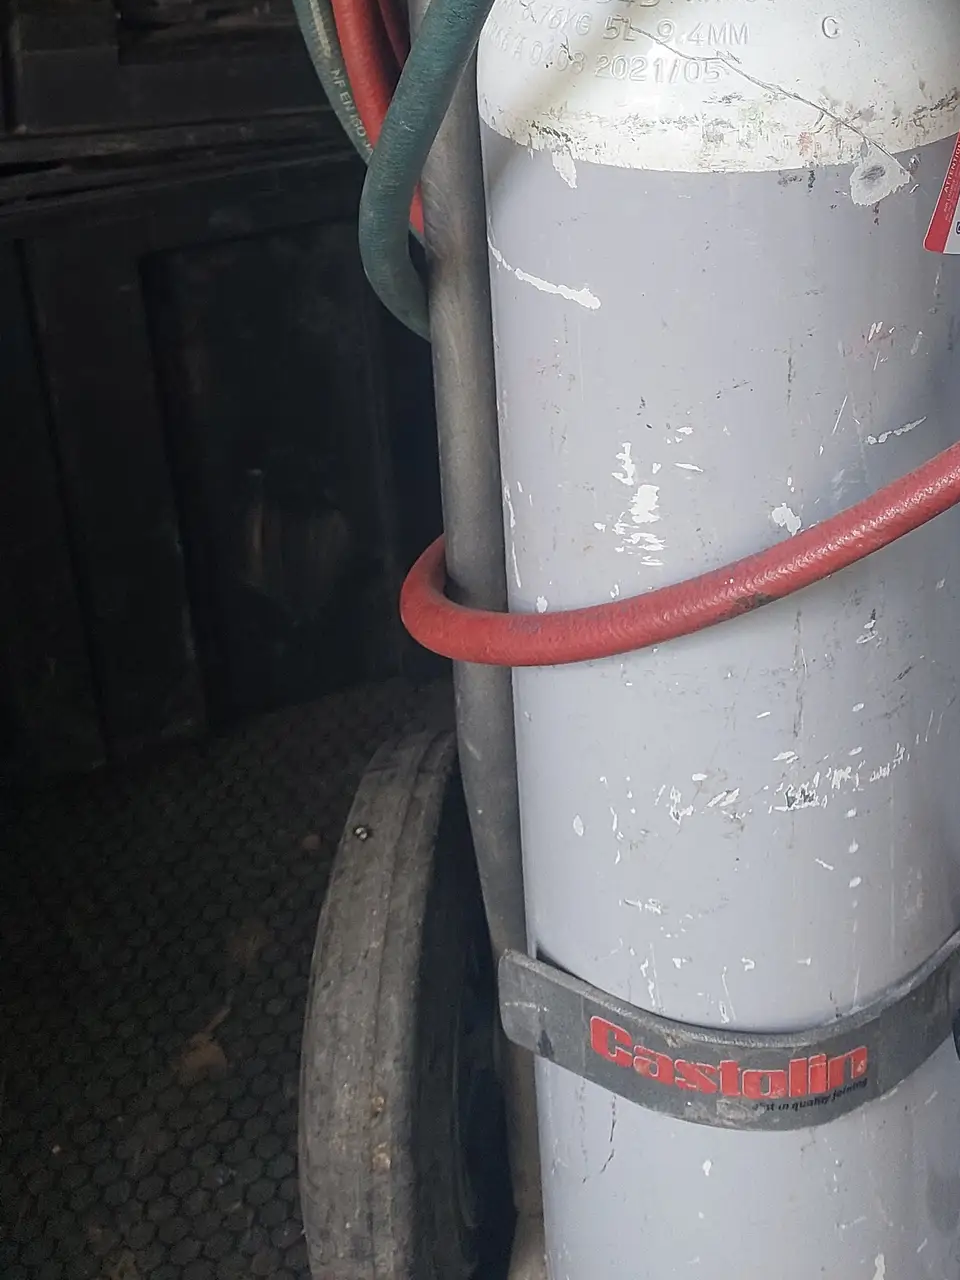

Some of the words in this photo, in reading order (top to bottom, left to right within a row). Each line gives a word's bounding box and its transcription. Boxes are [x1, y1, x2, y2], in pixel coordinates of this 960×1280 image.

[821, 15, 841, 39] C
[330, 68, 346, 88] NF
[340, 91, 356, 111] EN
[589, 1015, 868, 1100] Castolin
